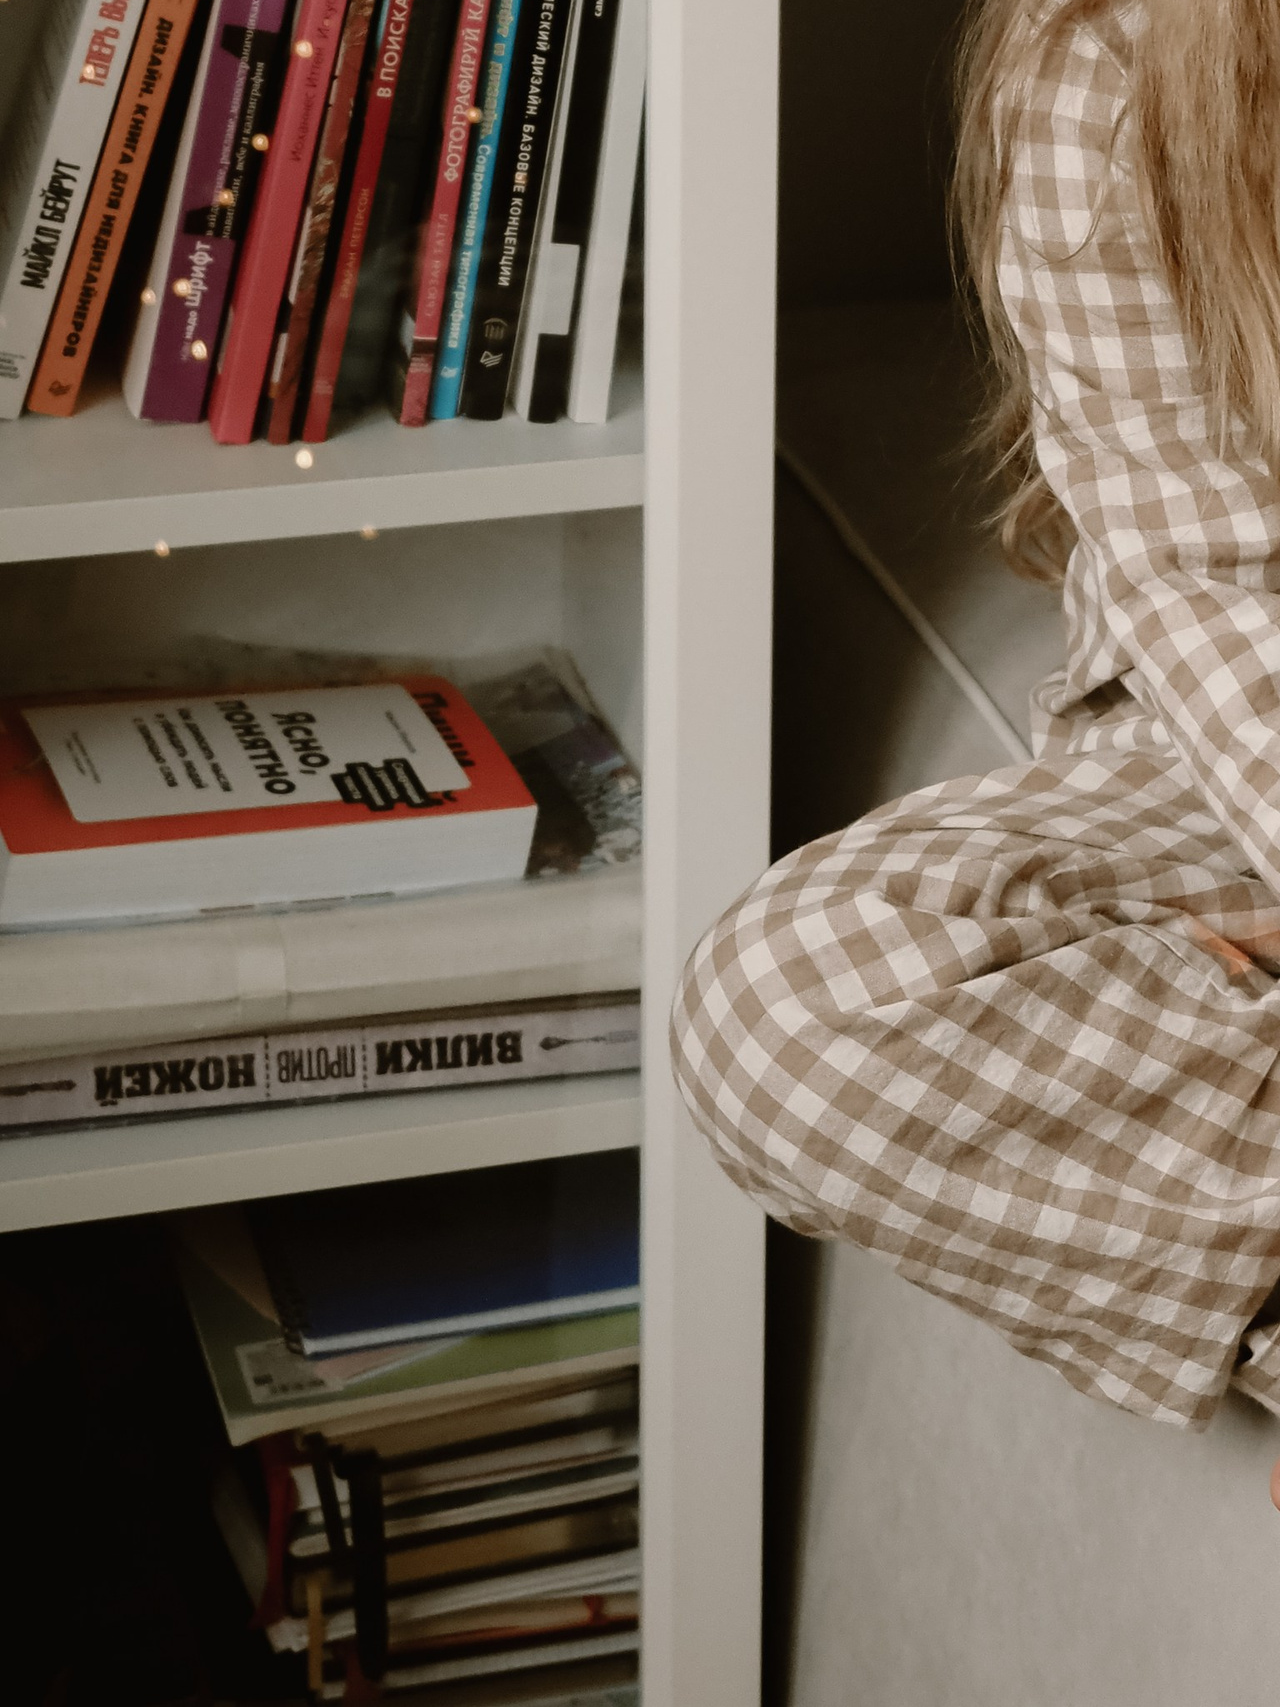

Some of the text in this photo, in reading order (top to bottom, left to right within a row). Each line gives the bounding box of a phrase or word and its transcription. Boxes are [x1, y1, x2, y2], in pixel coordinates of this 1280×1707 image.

[76, 22, 122, 90] ТЕПЕРЬ
[376, 87, 392, 98] В
[522, 53, 548, 120] ДИЗАЙН.
[217, 114, 240, 165] рекламе,
[436, 26, 484, 183] ФОТОГРАФИРУЙ
[62, 16, 177, 358] ДИЗАЙН. КНИГА ДЛЯ НЕДИЗАЙНЕРОВ
[220, 173, 243, 238] навигции,
[235, 146, 247, 171] вебе
[242, 61, 265, 134] каллиграфия
[510, 122, 535, 193] БАЗОВЫЕ
[20, 159, 81, 290] МАЙКЛ БЕЙРУТ
[349, 188, 369, 248] ПЕТЕРСОН
[459, 143, 491, 246] Современная
[184, 241, 213, 307] шрифт
[424, 213, 449, 317] СЬЮЗАН ТАТТЛ
[497, 197, 523, 286] КОНЦЕПЦИИ
[447, 249, 476, 349] типографика
[215, 698, 296, 795] понятно
[272, 711, 329, 775] Ясно,
[94, 1031, 523, 1107] ВИЛКИ ПРОТИВ НОЖЕЙ
